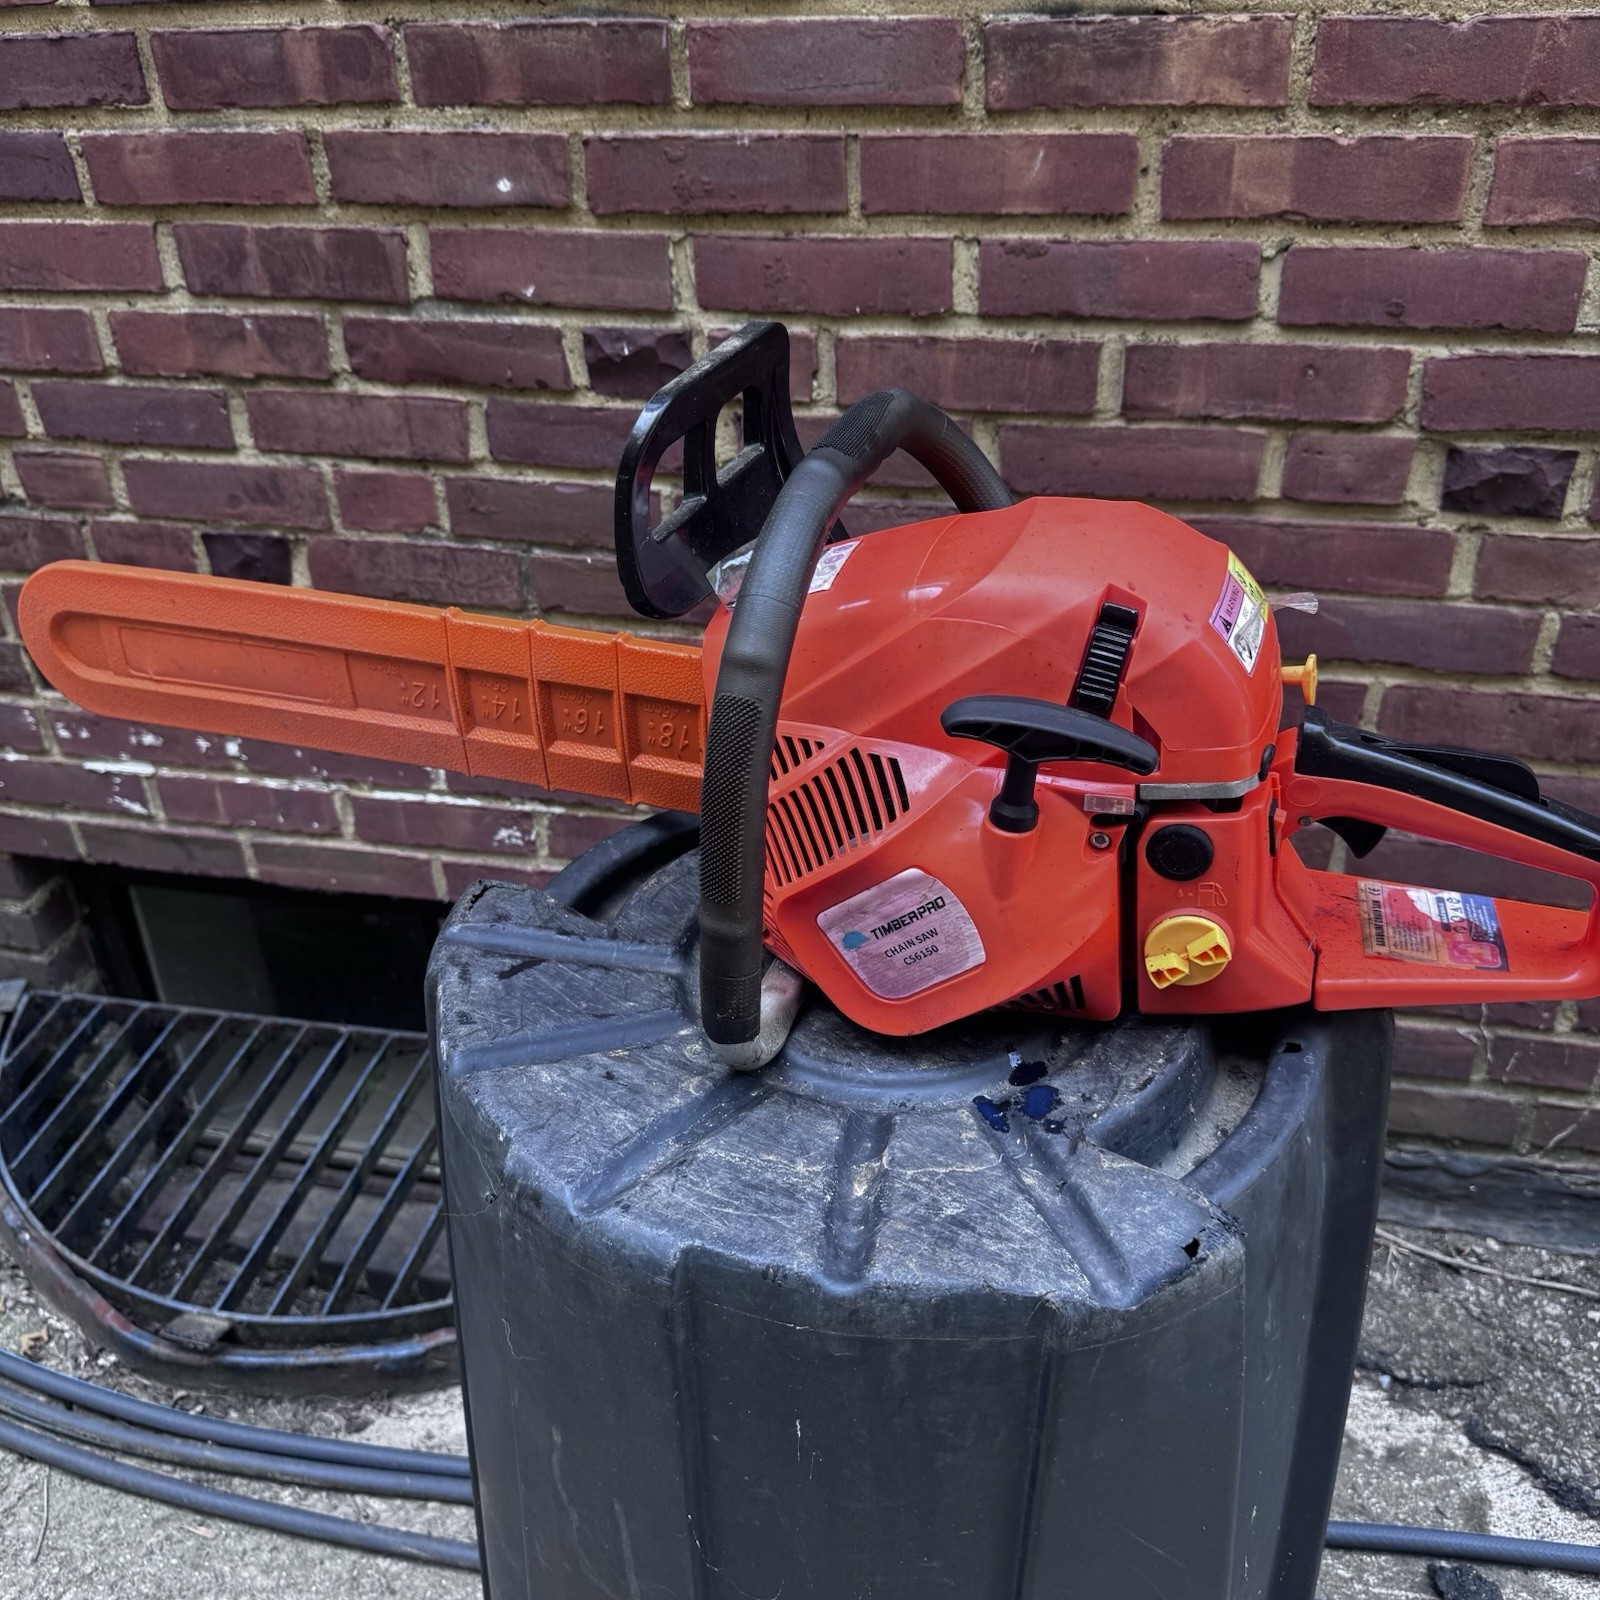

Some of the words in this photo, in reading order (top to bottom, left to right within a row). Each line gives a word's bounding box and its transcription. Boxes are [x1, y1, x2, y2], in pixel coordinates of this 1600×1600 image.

[870, 895, 946, 940] TIMBERPRO
[884, 938, 917, 959] CHAIN
[916, 927, 939, 944] SAW
[903, 944, 939, 966] CS6150
